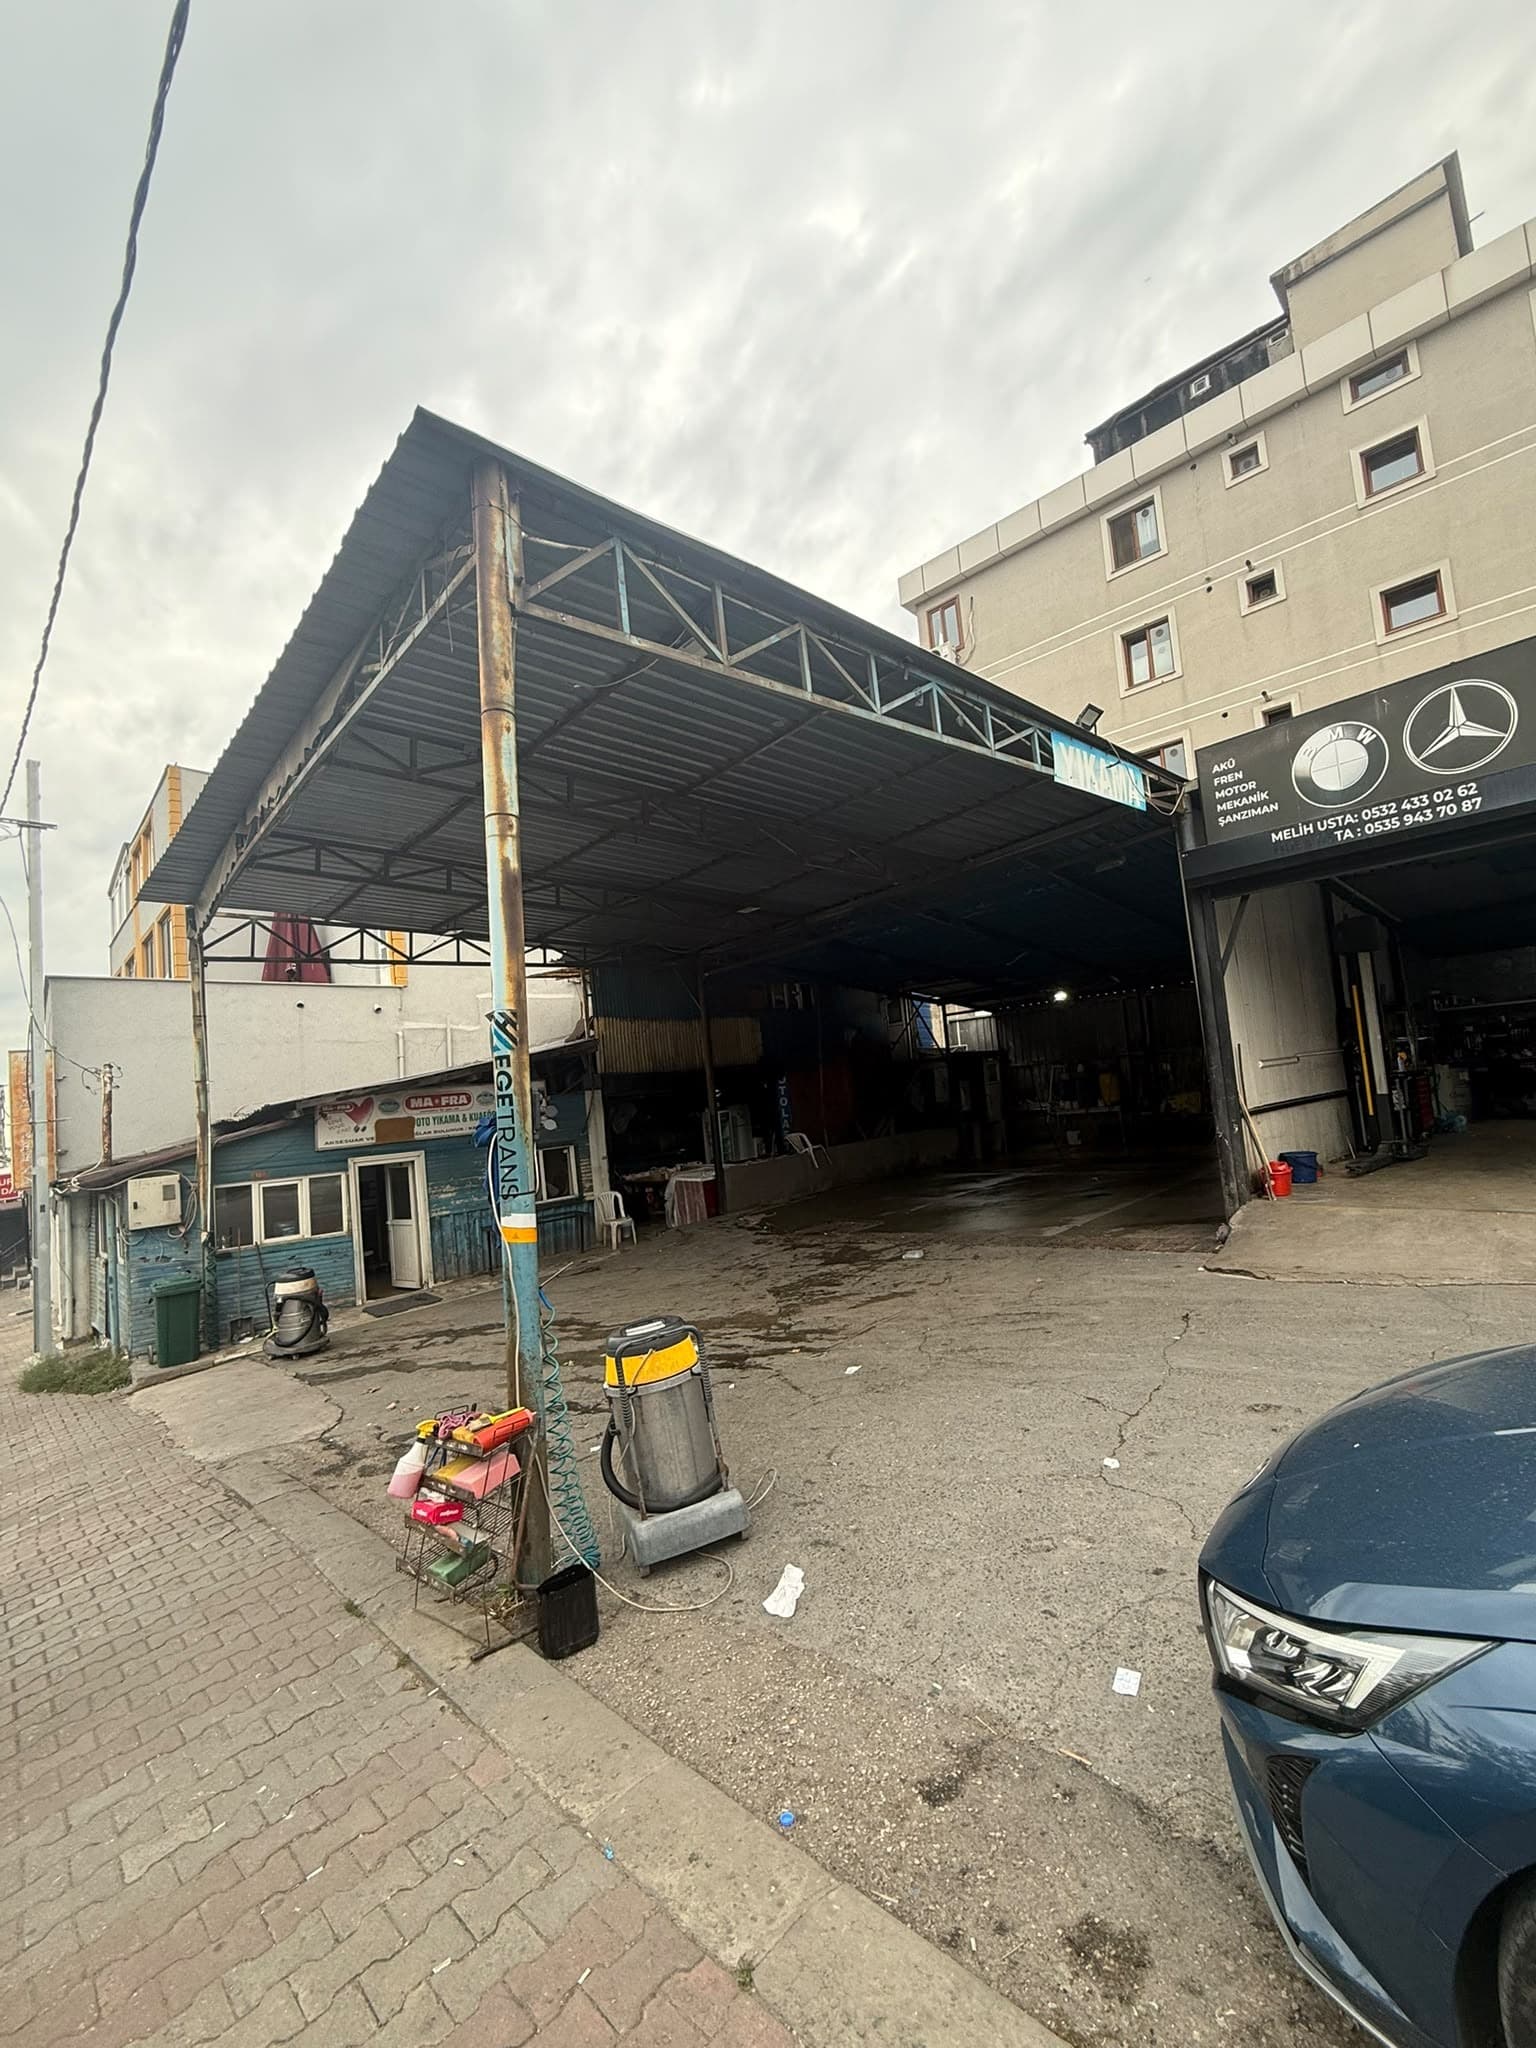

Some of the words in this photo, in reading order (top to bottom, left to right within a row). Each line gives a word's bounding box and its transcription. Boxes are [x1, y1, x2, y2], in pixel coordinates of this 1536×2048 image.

[1302, 725, 1377, 761] BMW
[1212, 758, 1237, 774] AKÜ
[1213, 770, 1244, 787] FREN
[1215, 780, 1257, 800] MOTOR
[1216, 789, 1270, 813] MEKANİK
[1271, 821, 1315, 844] MELİH
[1317, 814, 1359, 833] USTA:
[1360, 802, 1398, 822] 0532
[1400, 793, 1430, 814] 433
[1432, 788, 1455, 805] 02
[1456, 782, 1479, 799] 62
[1217, 802, 1280, 827] ŞANZIMAN
[1364, 816, 1401, 836] 0535
[1403, 808, 1434, 827] 943
[1435, 802, 1458, 820] 70
[1460, 796, 1483, 814] 87
[416, 1116, 431, 1127] OTO
[432, 1113, 461, 1126] YIKAMA
[462, 1113, 468, 1123] &
[493, 1054, 519, 1201] EGETRANS
